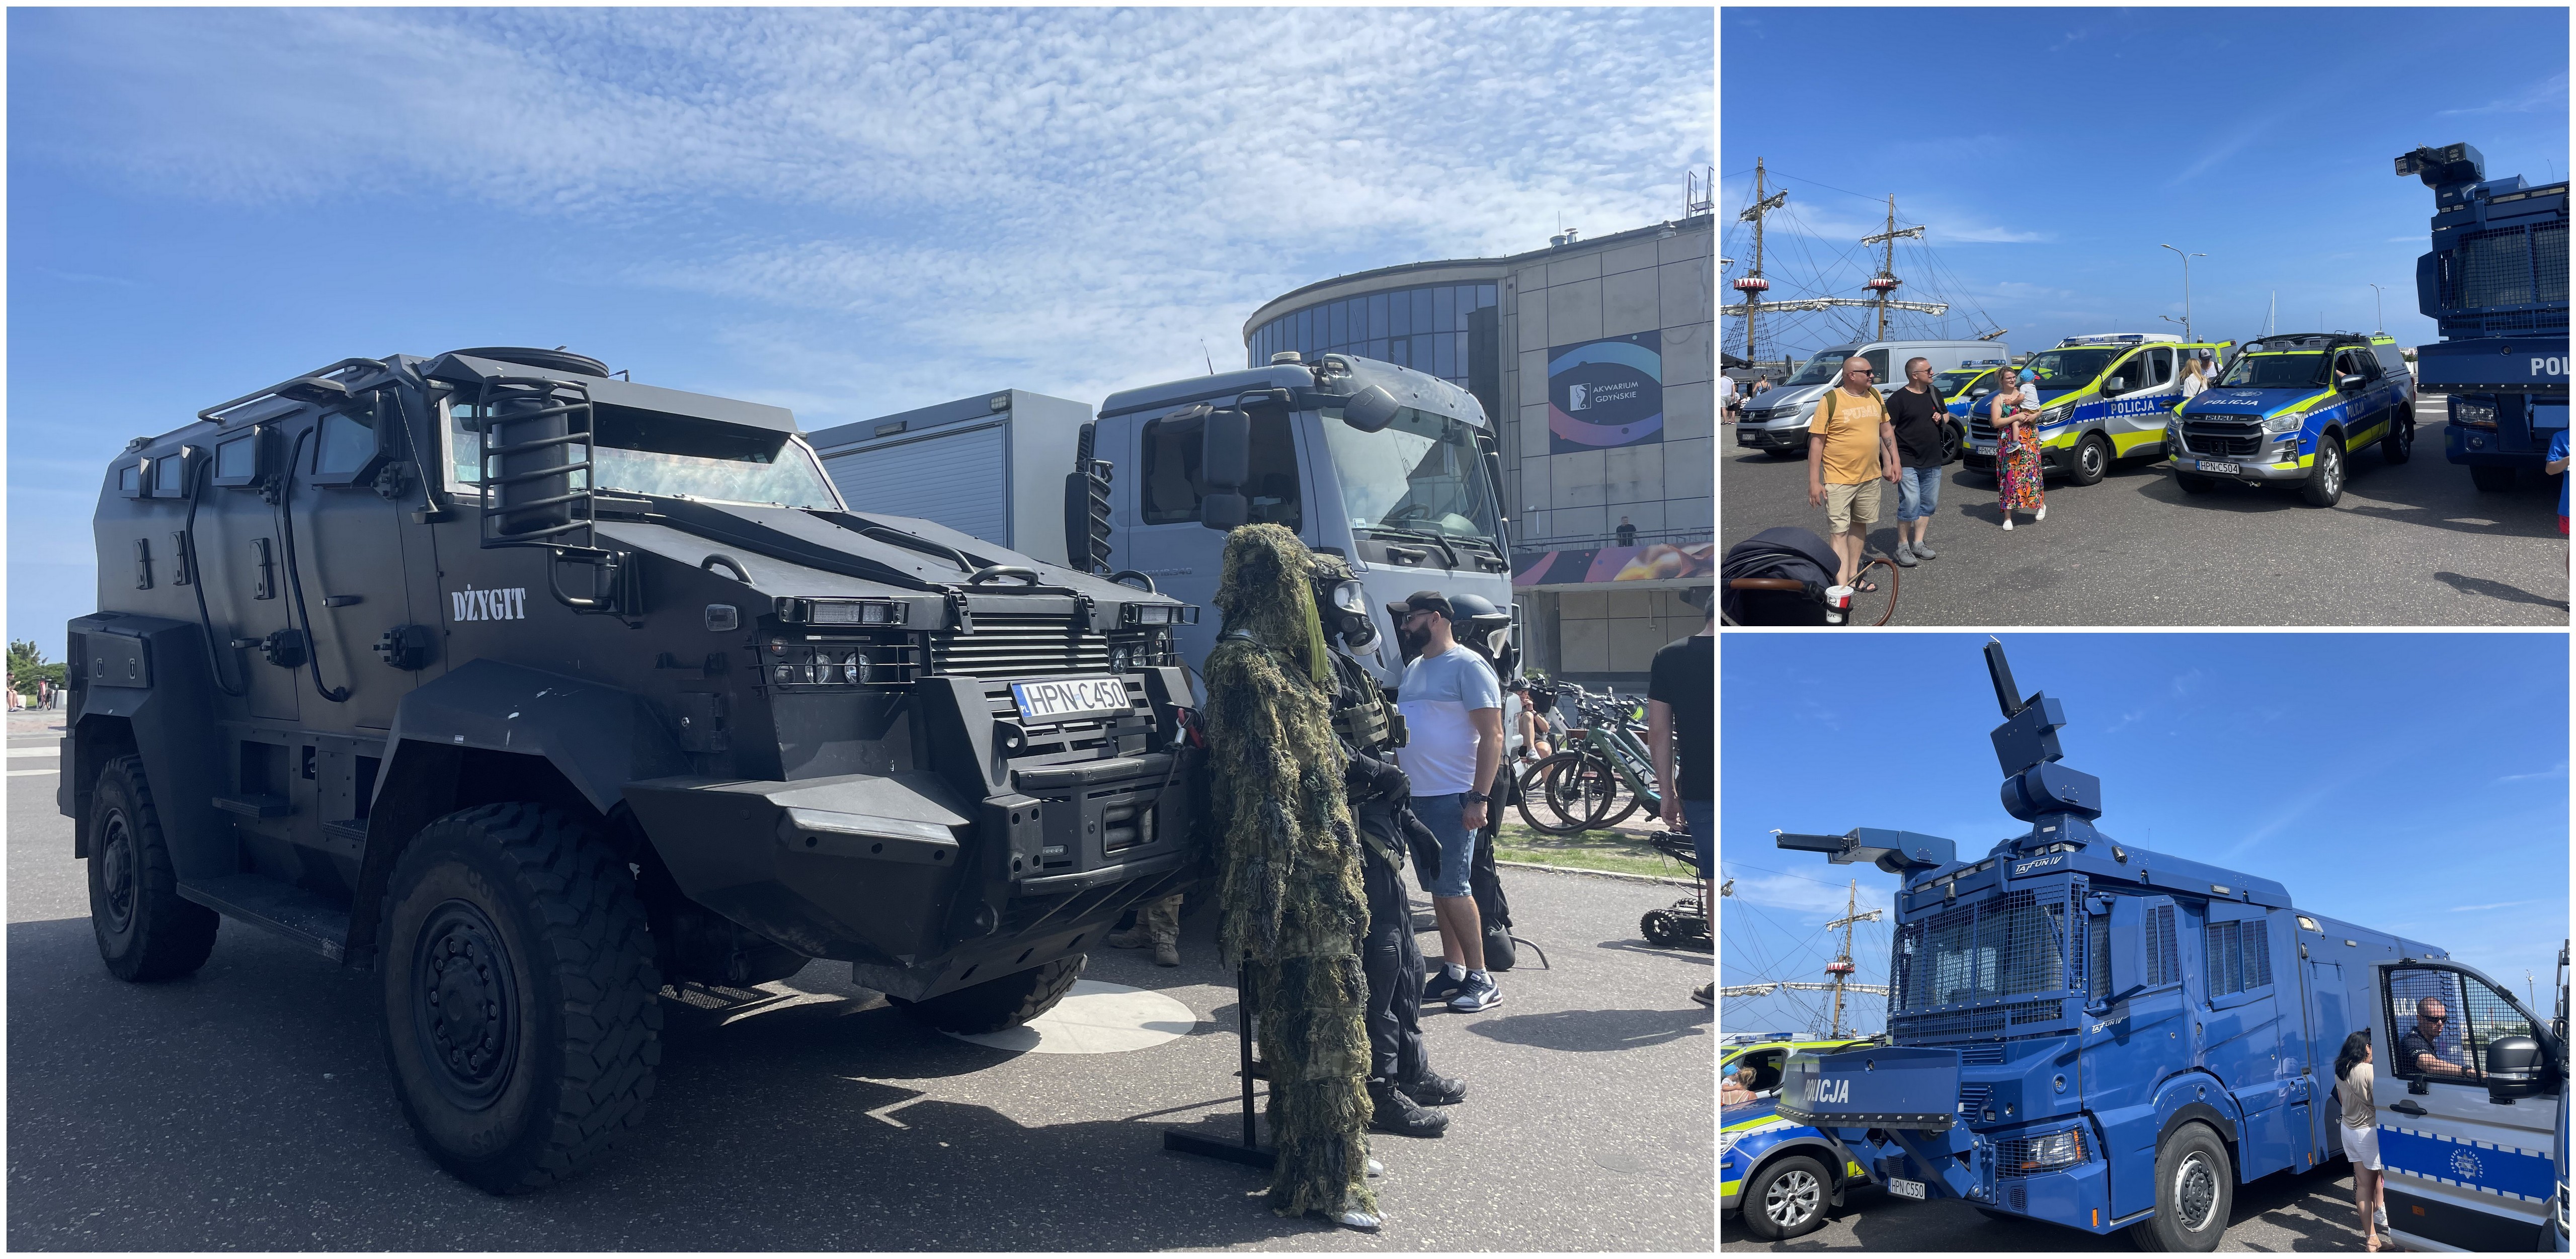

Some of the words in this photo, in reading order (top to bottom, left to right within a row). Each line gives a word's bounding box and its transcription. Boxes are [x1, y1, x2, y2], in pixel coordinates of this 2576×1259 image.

[1593, 381, 1639, 393] AKWARIUM
[1595, 391, 1637, 403] GDYŃSKIE
[1841, 404, 1880, 424] PUMA
[2111, 400, 2155, 414] POLICJA
[2346, 401, 2365, 419] POLICJA
[1979, 446, 1988, 455] HPN
[2201, 462, 2216, 471] HPN
[2218, 463, 2238, 473] C504
[451, 583, 526, 621] DŻYGIT
[1020, 705, 1029, 713] PL
[1026, 684, 1079, 714] HPN
[1079, 682, 1126, 709] C450
[1604, 742, 1633, 774] SCOTT
[2015, 858, 2050, 874] TAJFUN
[2050, 856, 2063, 865] IV
[2092, 1019, 2115, 1034] TAJFUN
[2115, 1017, 2123, 1025] IV
[1803, 1079, 1849, 1103] POLICJA
[2450, 1148, 2461, 1173] POMAGAMY
[2469, 1151, 2483, 1178] CHRONIMY
[1892, 1180, 1904, 1194] HPN
[1906, 1182, 1923, 1198] C550
